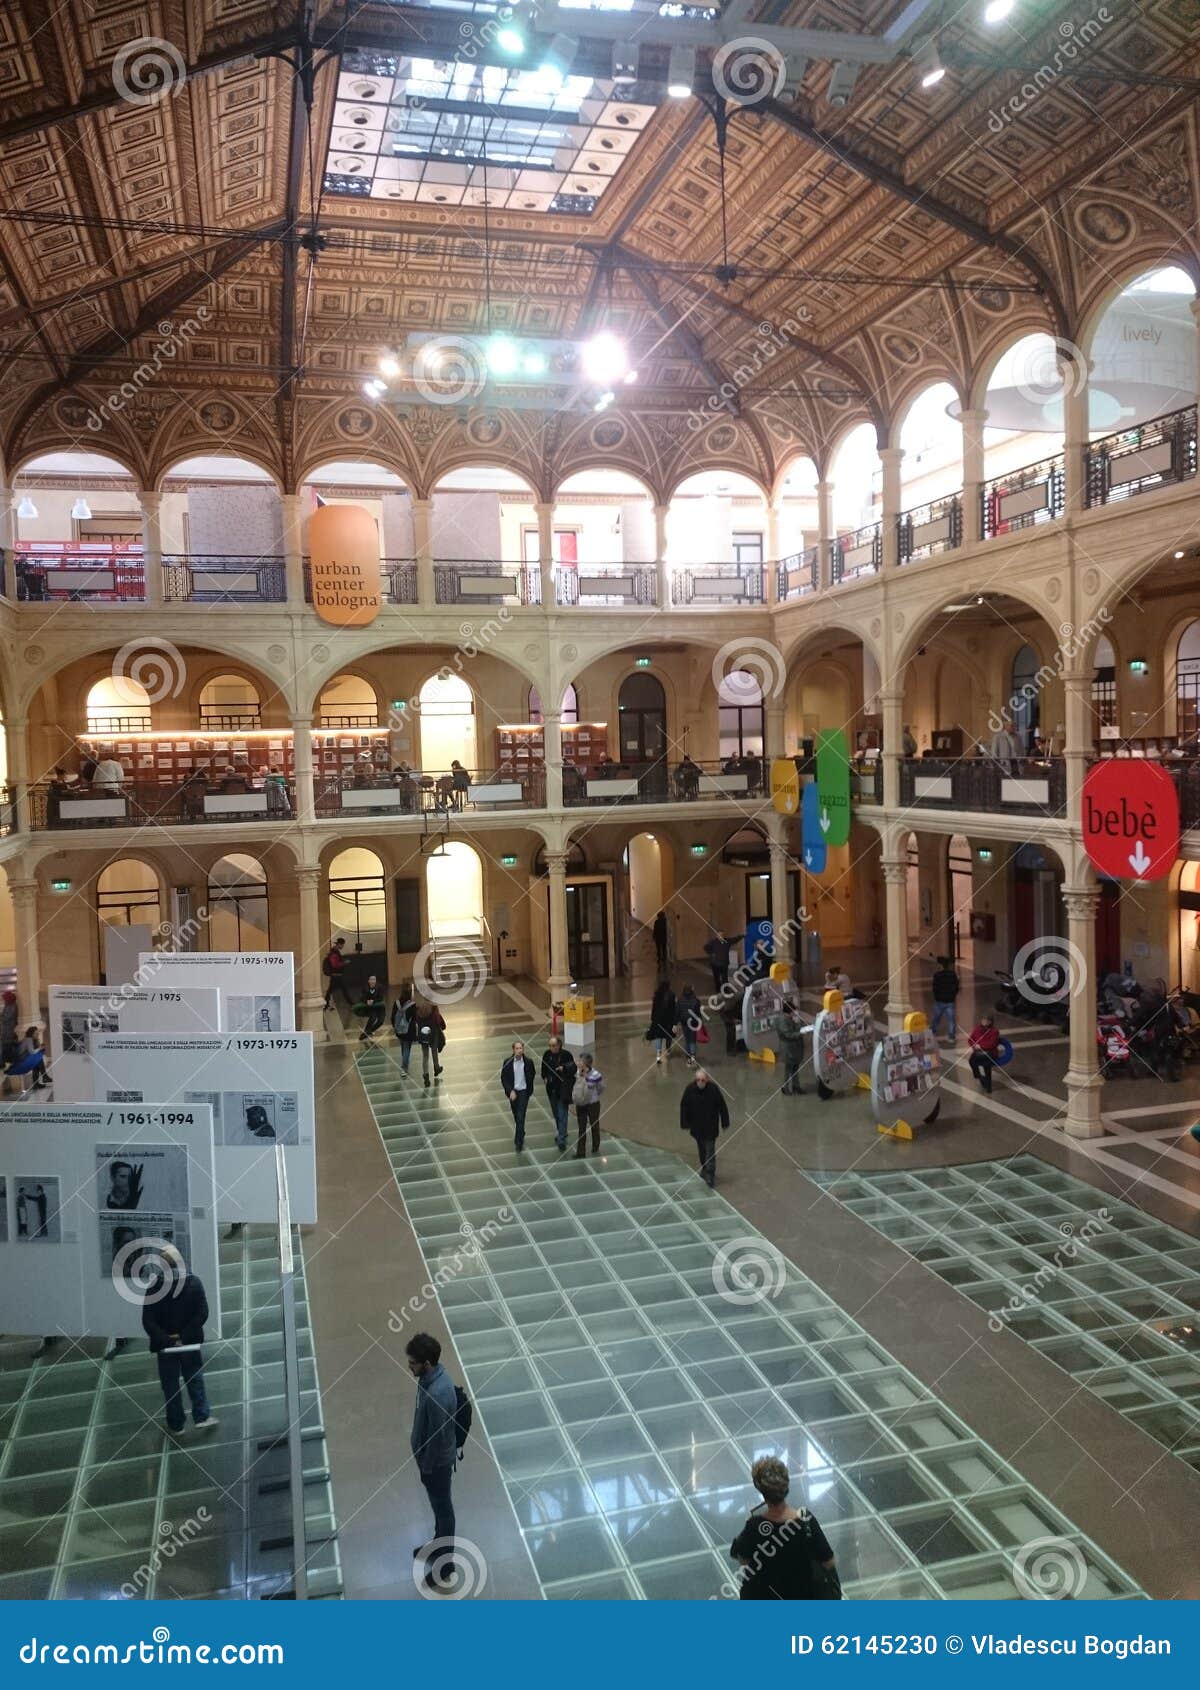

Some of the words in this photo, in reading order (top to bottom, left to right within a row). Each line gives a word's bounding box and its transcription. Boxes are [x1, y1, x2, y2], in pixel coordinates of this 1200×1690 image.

[1122, 323, 1162, 345] lively
[315, 561, 361, 576] urban
[315, 579, 365, 591] center
[316, 592, 378, 610] bologna
[1085, 795, 1157, 840] bebè
[241, 957, 284, 965] 1975-1976
[159, 992, 181, 1002] 1975
[236, 1039, 298, 1050] 1973-1975
[119, 1112, 194, 1125] 1961-1994
